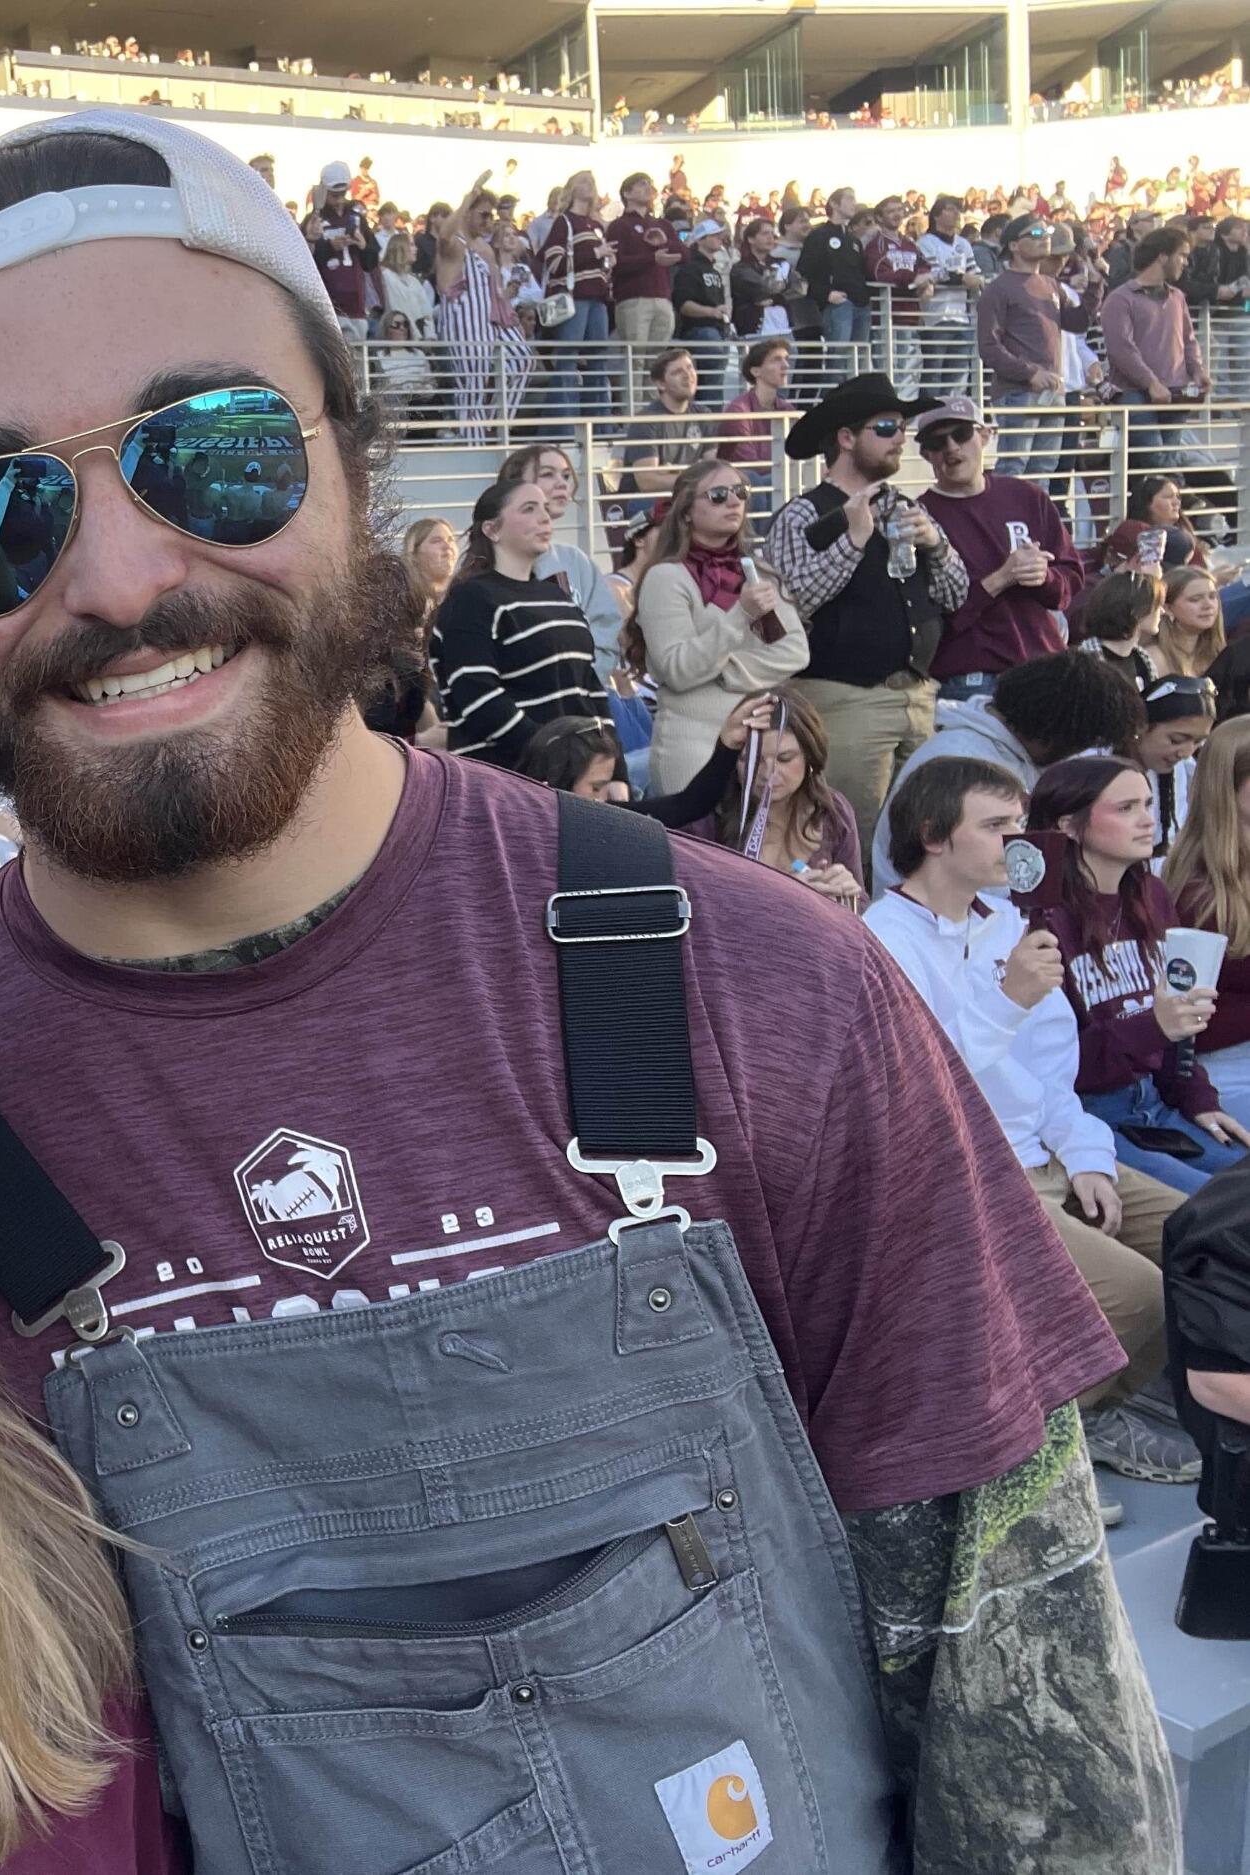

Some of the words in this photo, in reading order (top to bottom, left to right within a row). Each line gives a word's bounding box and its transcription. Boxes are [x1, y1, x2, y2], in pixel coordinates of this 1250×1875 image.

[266, 1227, 348, 1251] RELIAQUEST
[302, 1246, 330, 1257] BOWL
[707, 1828, 761, 1868] carhartt
